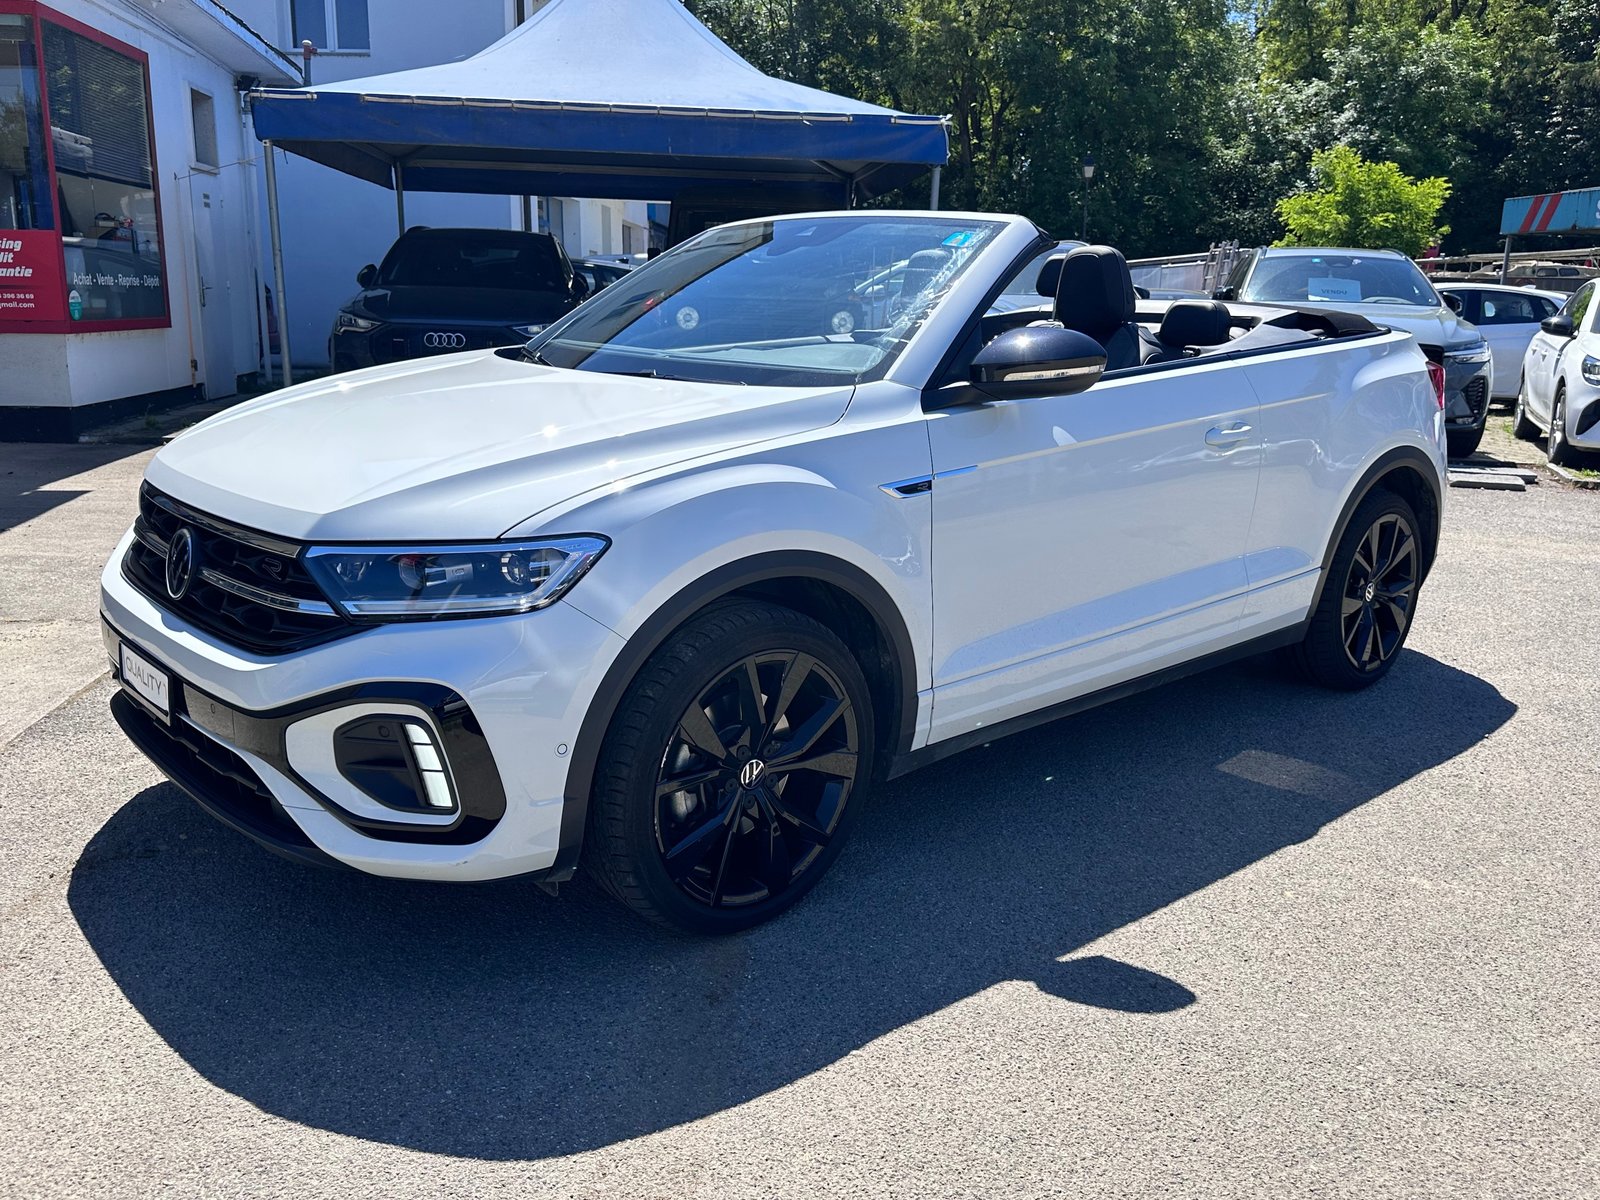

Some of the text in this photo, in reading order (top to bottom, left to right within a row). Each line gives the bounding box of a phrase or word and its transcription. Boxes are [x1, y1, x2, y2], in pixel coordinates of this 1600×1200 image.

[0, 238, 22, 251] ing
[73, 272, 93, 286] Achat
[96, 273, 114, 286] Vente
[118, 274, 140, 289] Reprise
[1320, 288, 1348, 296] VENDU
[125, 656, 162, 695] QUALITY
